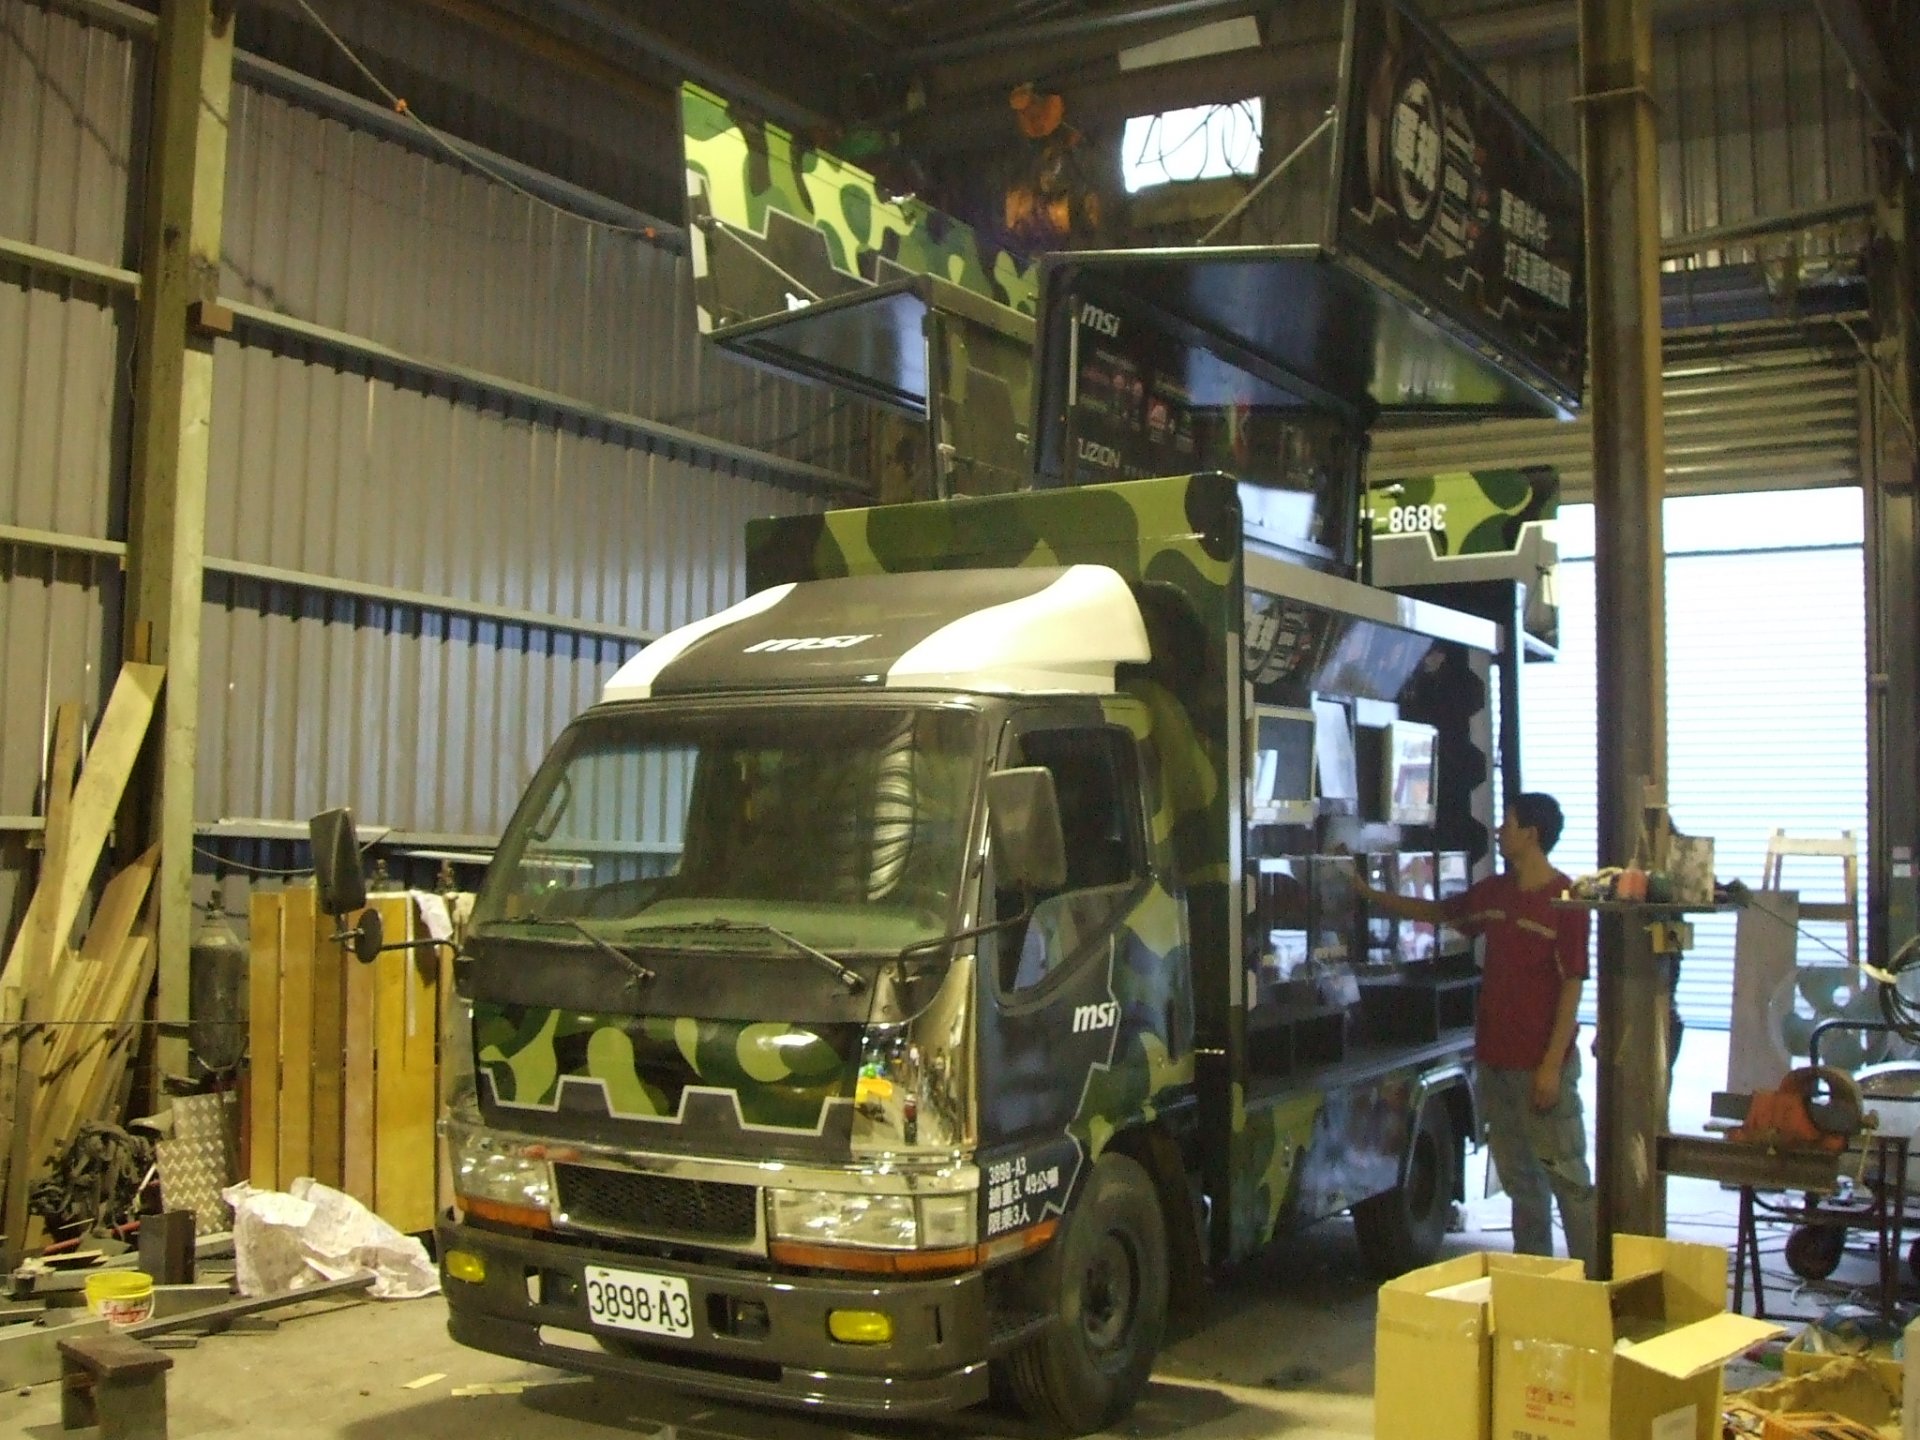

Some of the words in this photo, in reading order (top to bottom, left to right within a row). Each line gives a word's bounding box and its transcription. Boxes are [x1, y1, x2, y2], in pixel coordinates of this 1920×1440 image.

[1081, 303, 1120, 338] msi
[743, 634, 882, 652] msi
[1072, 1001, 1116, 1034] msi
